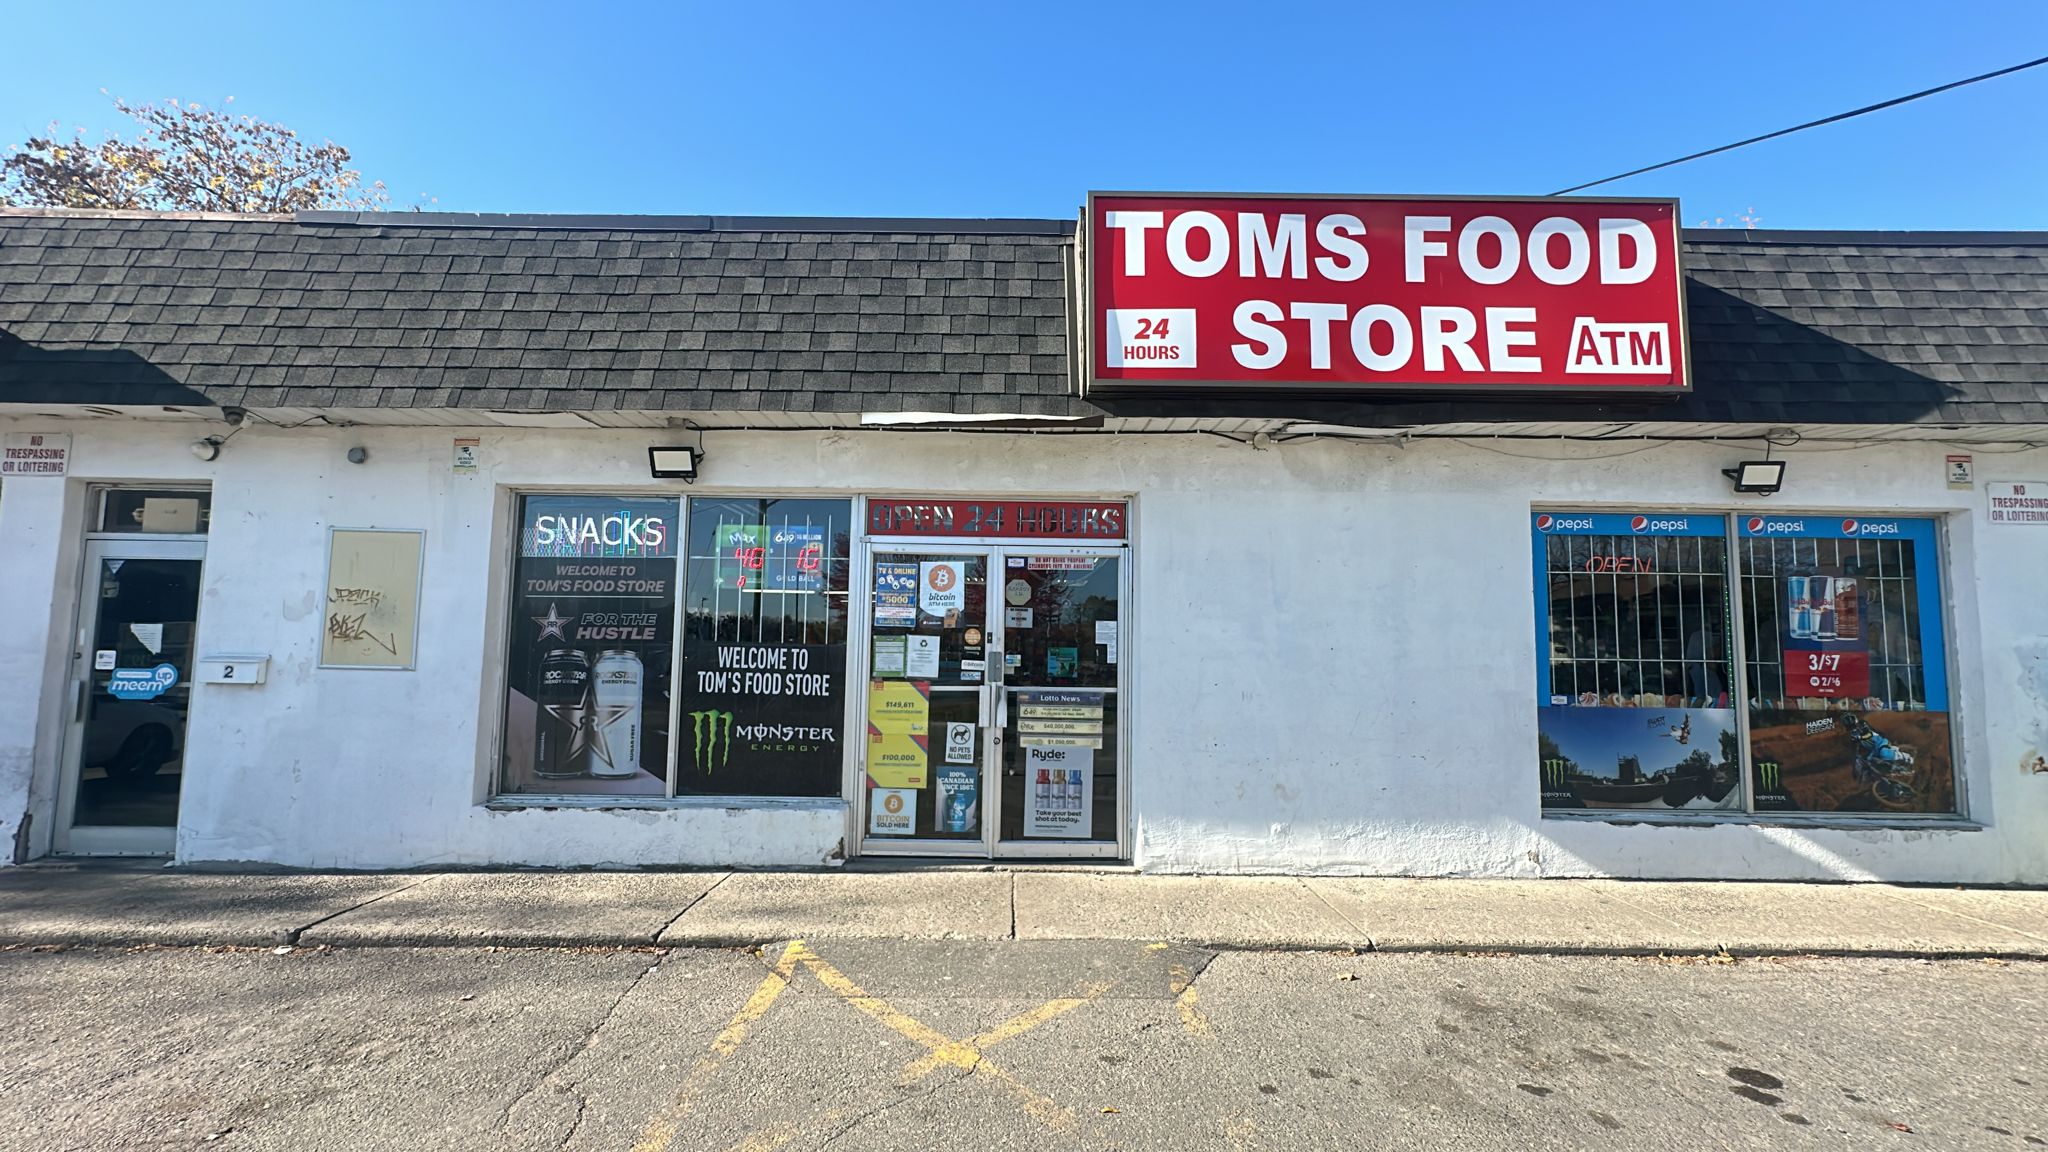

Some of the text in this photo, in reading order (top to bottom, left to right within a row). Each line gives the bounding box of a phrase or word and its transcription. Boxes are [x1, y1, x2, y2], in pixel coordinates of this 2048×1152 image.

[1105, 210, 1657, 285] TOMS FOOD
[1134, 318, 1169, 339] 24
[1231, 299, 1542, 373] STORE
[1124, 344, 1179, 360] HOURS
[1574, 324, 1663, 367] ATM
[30, 435, 43, 446] NO
[5, 448, 65, 459] TRESPASSING
[2, 461, 64, 472] OR LOITERING
[2013, 485, 2025, 495] NO
[1992, 497, 2048, 508] TRESPASSING
[873, 503, 1120, 534] OPEN 24 HOURS
[1992, 510, 2004, 521] OR
[536, 515, 663, 546] SNACKS
[1556, 518, 1593, 531] pepsi
[1651, 519, 1688, 532] pepsi
[1767, 520, 1804, 534] pepsi
[1861, 522, 1899, 535] pepsi
[729, 531, 756, 545] MAX
[556, 565, 636, 576] WELCOME TO
[1585, 556, 1652, 574] OPEN
[527, 579, 665, 592] TOM'S FOOD STORE
[928, 593, 956, 601] bitcoin
[581, 612, 657, 626] FOR THE
[576, 627, 656, 640] HUSTLE
[718, 646, 809, 670] WELCOME TO
[1809, 654, 1840, 671] 3/$7
[157, 671, 172, 682] up
[223, 665, 234, 678] 2
[112, 680, 163, 691] meem
[697, 671, 830, 696] TOM'S FOOD STORE
[1040, 694, 1059, 702] Lotto
[886, 701, 915, 709] $149,611
[736, 723, 835, 742] MONSTER
[751, 744, 819, 752] ENERGY
[882, 754, 915, 762] $100,000
[947, 752, 972, 760] ALLOWED
[1032, 749, 1065, 761] Ryde:
[876, 815, 910, 823] BITCOIN
